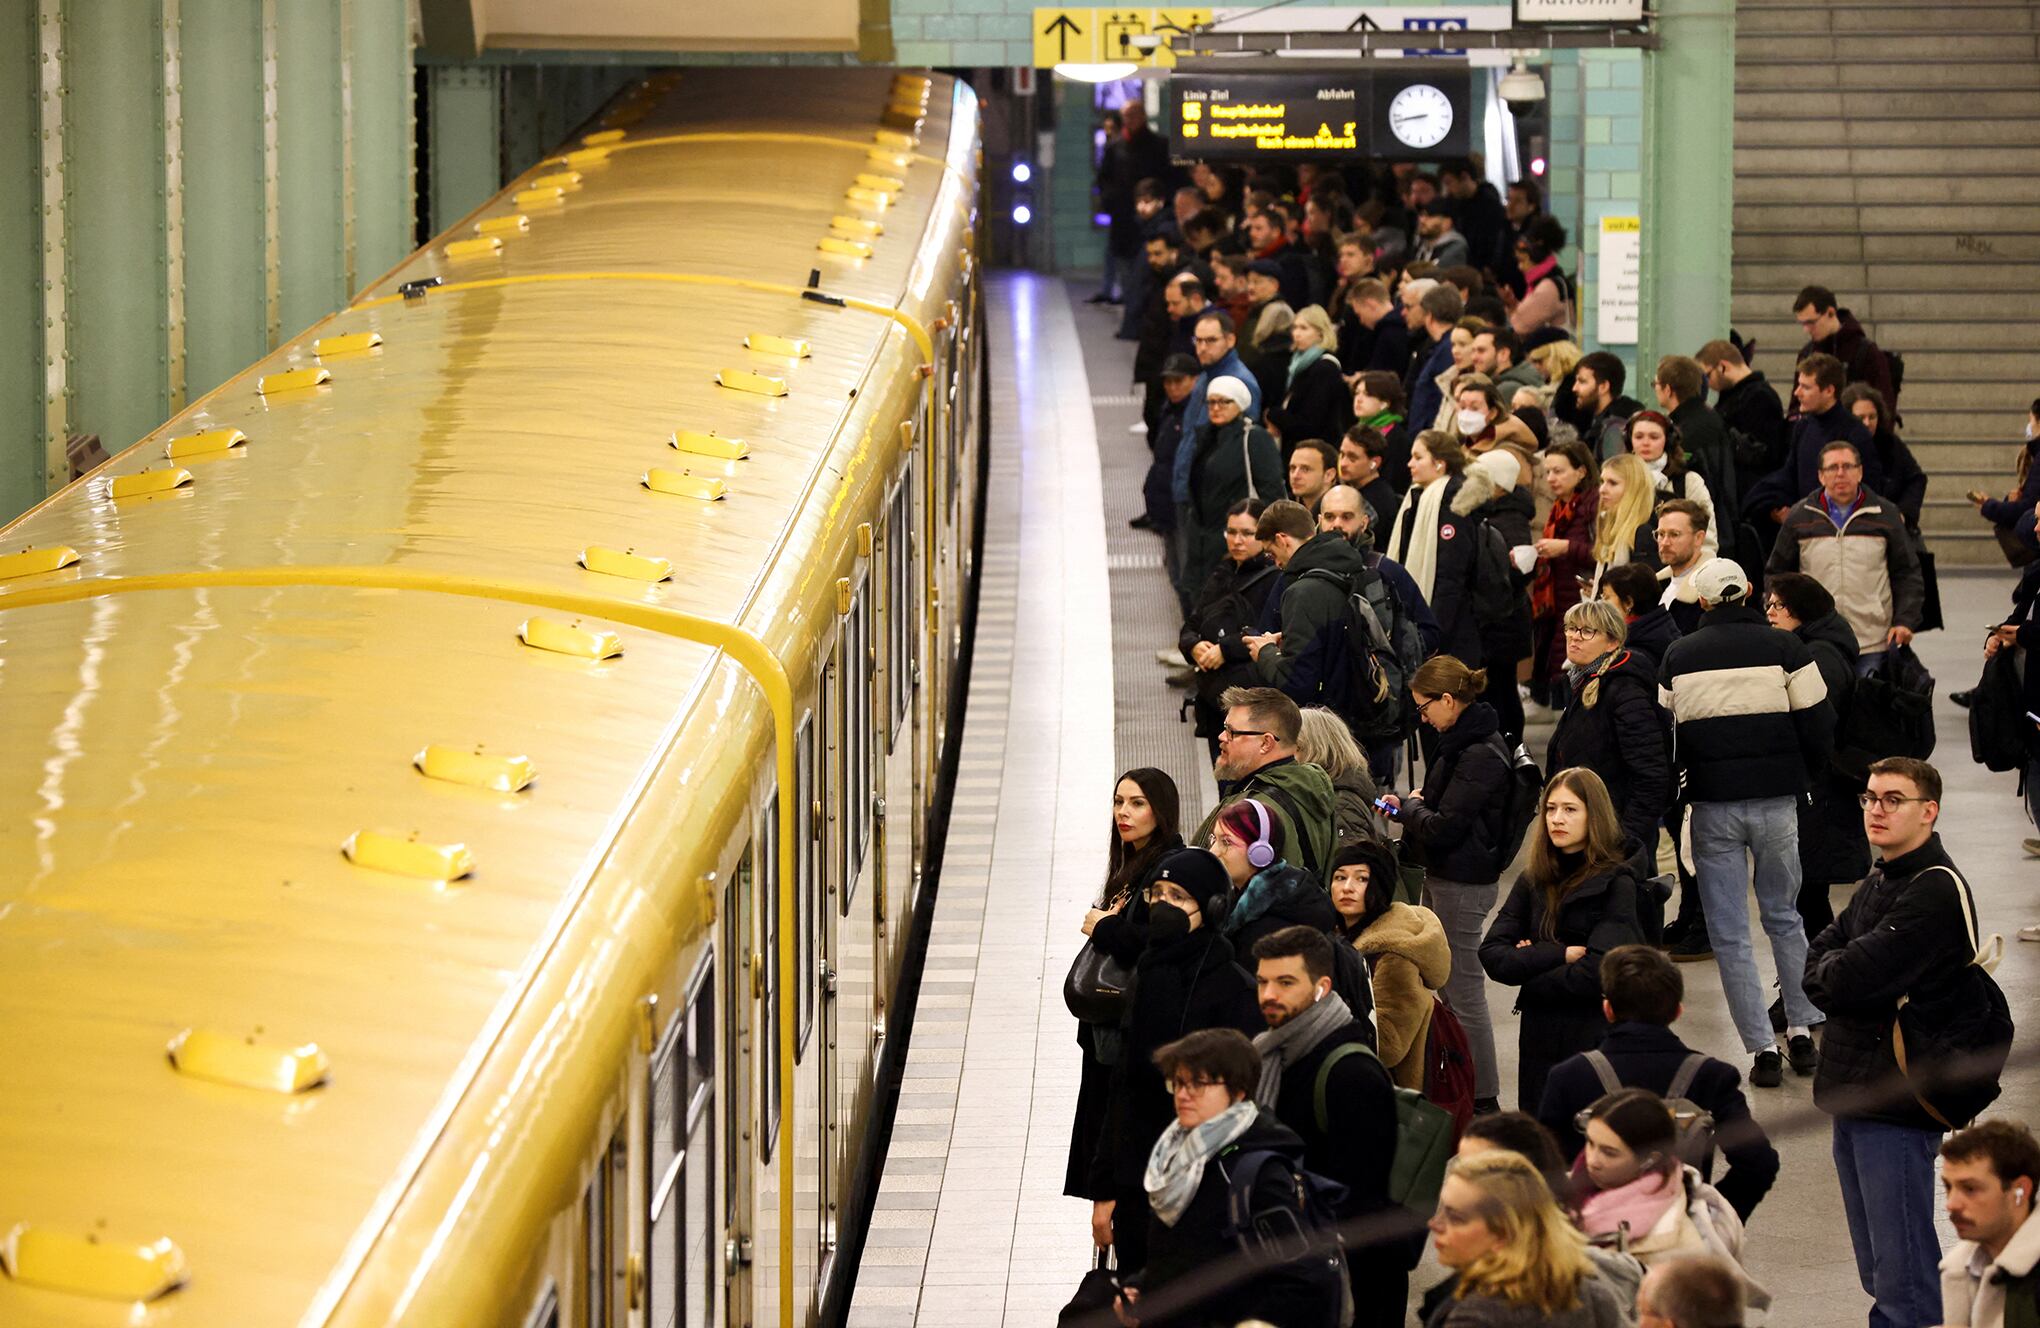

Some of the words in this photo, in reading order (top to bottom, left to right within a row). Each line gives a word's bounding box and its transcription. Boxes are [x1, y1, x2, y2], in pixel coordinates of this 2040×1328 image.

[1183, 90, 1208, 101] Linie
[1210, 90, 1229, 101] Ziel
[1316, 89, 1355, 101] Abfahrt
[1210, 104, 1285, 119] Hauptbahnhof
[1210, 123, 1285, 138] Hauptbahnhof
[1256, 136, 1284, 149] Nach
